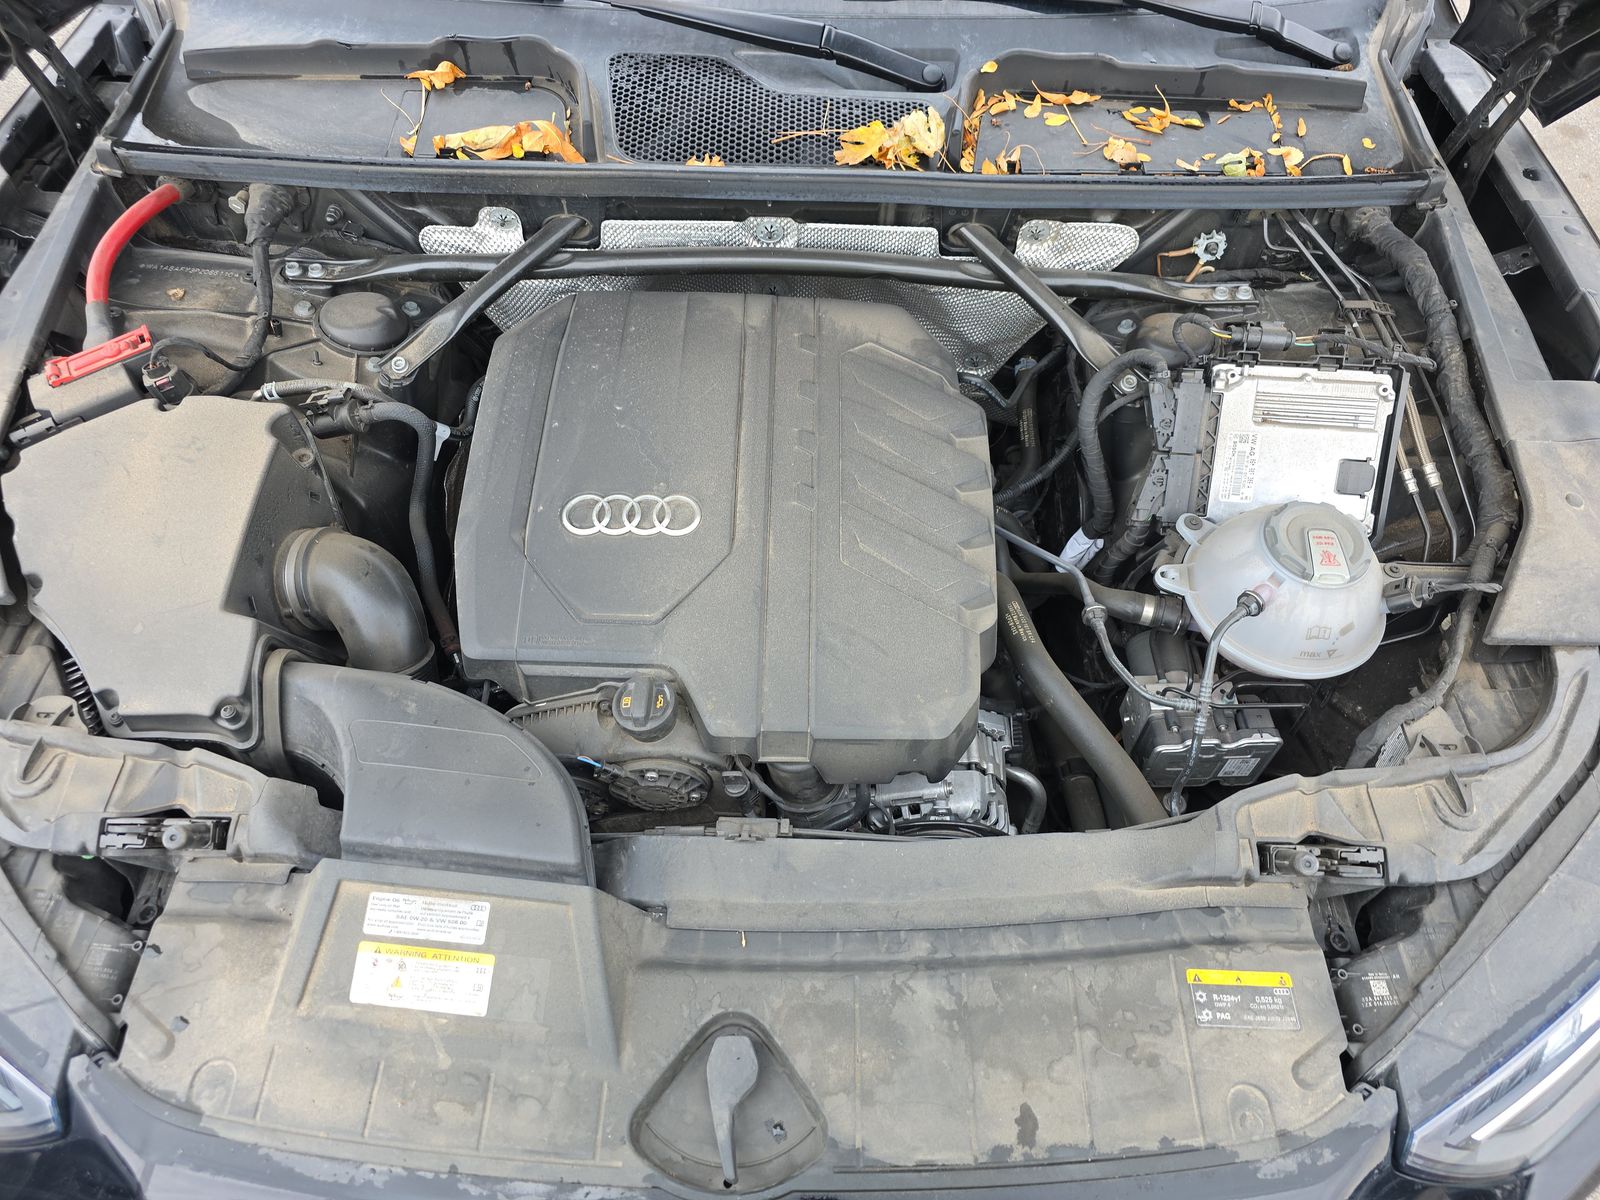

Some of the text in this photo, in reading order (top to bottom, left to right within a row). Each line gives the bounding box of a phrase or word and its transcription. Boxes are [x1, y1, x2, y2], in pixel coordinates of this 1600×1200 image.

[1250, 433, 1258, 445] VW
[1249, 446, 1256, 457] AG
[1300, 650, 1321, 658] max
[385, 946, 480, 964] WARNING ATTENTION
[1213, 994, 1241, 1003] R-1234yf
[1274, 996, 1283, 1005] kg
[1216, 1012, 1231, 1020] PAG
